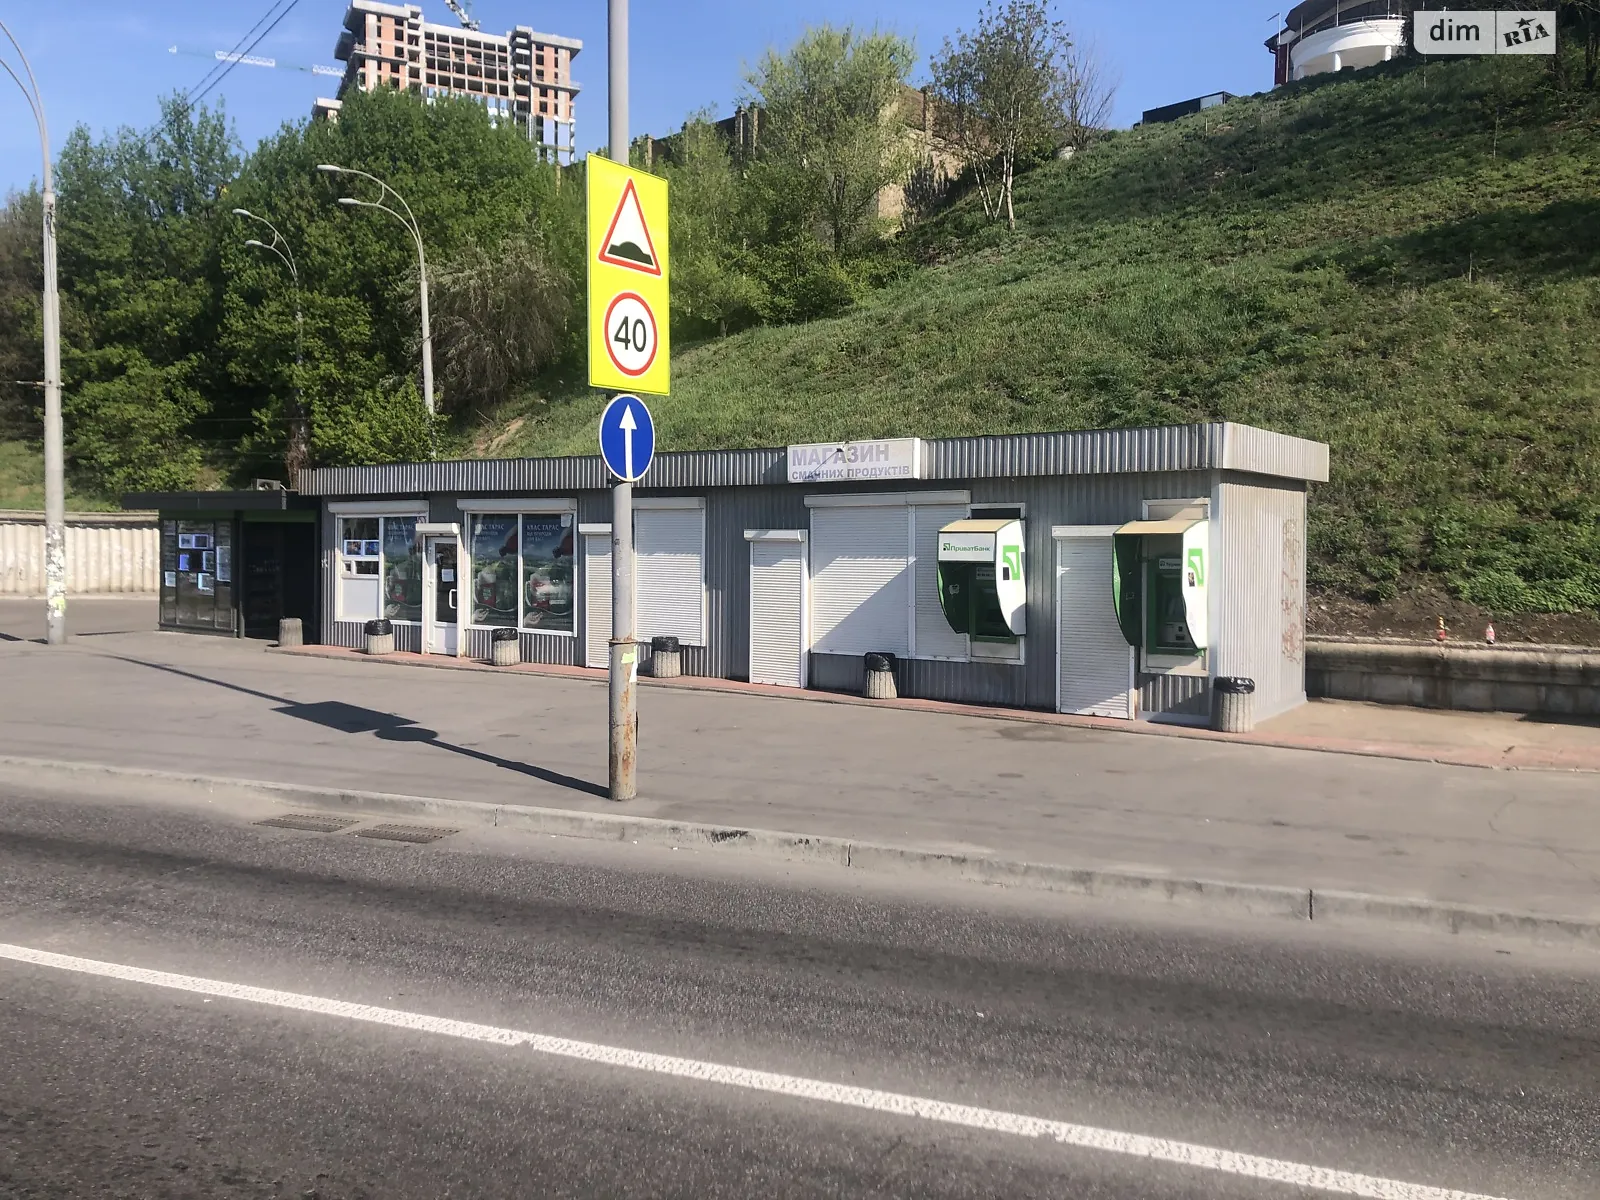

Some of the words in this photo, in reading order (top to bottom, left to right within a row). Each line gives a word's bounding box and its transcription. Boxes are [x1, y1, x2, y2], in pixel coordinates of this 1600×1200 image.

[614, 315, 646, 353] 40
[792, 444, 889, 467] МАГАЗИН
[792, 468, 844, 481] СМАЧНИХ
[847, 466, 910, 479] ПРОДУКТІВ
